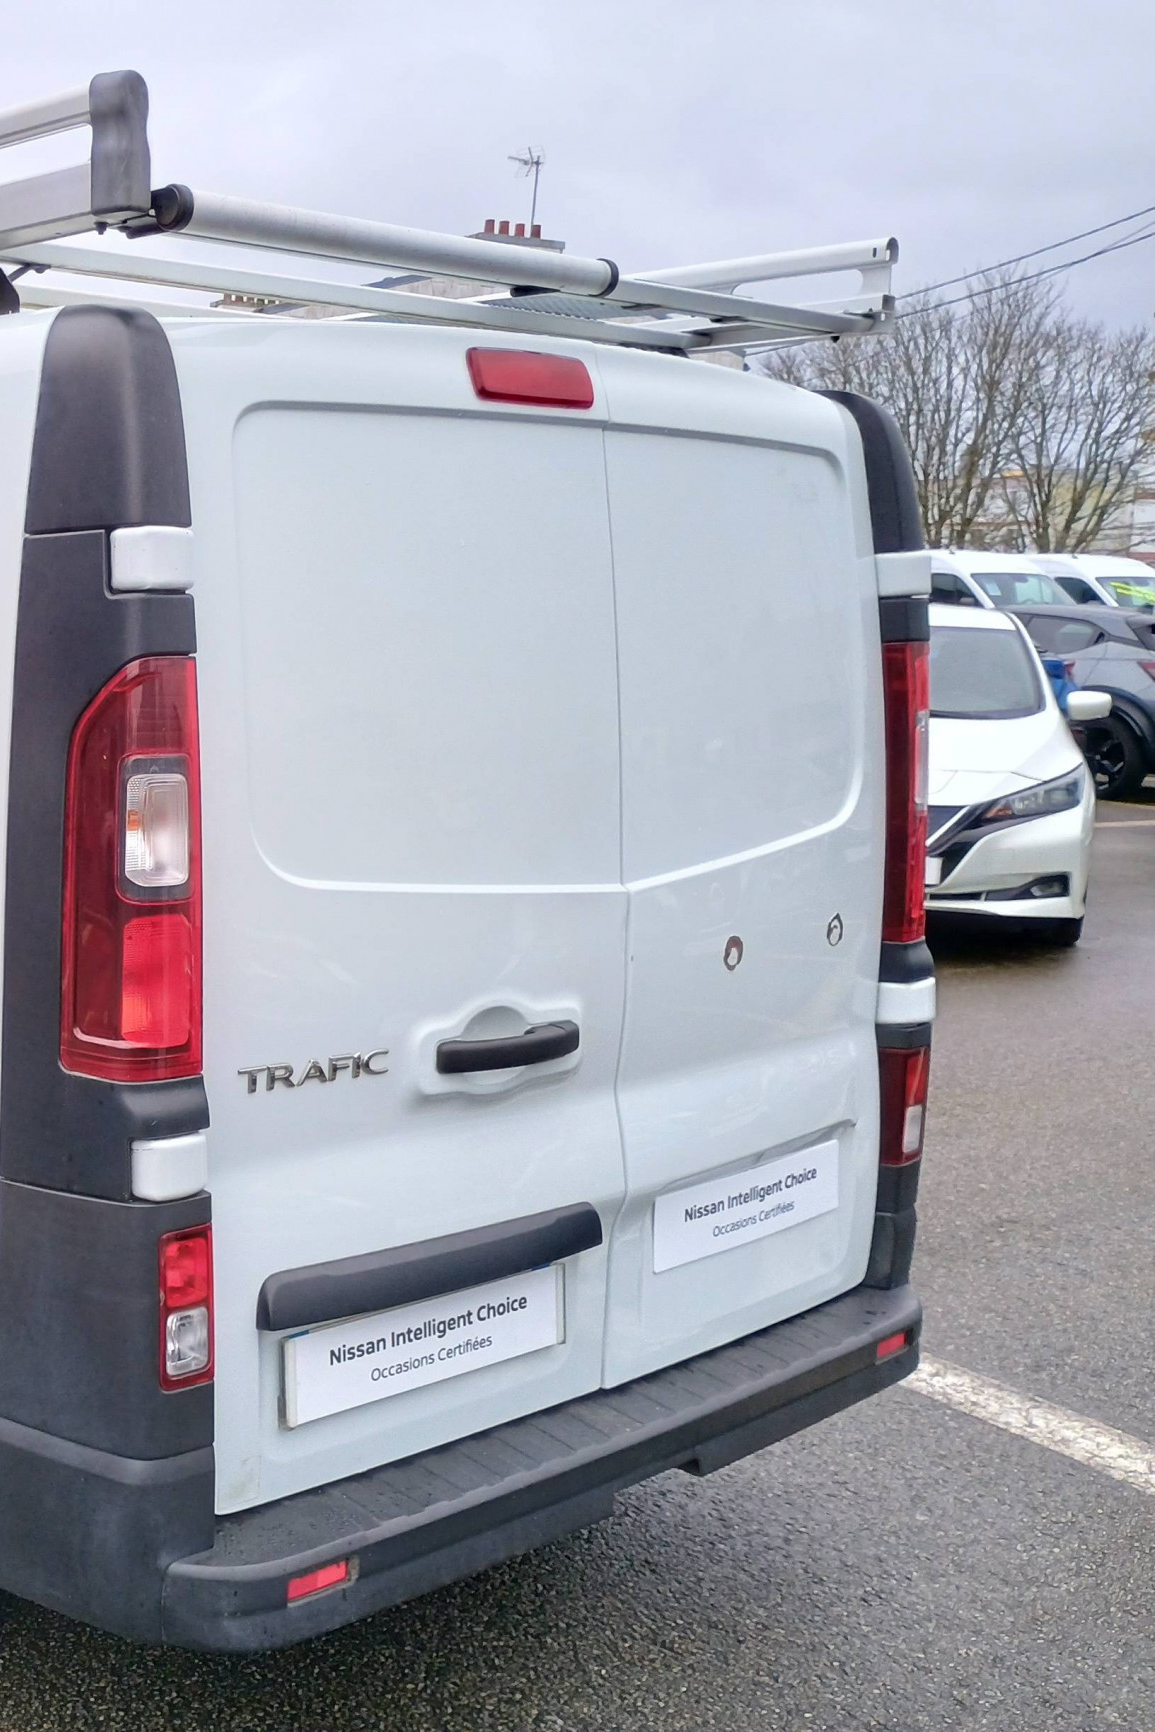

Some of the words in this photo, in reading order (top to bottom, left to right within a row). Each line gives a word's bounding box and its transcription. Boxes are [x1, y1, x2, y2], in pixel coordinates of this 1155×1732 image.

[237, 1048, 390, 1094] TRAFIC
[684, 1200, 725, 1222] Nissan
[727, 1179, 783, 1209] Intelligent
[784, 1167, 818, 1189] Choice
[712, 1214, 757, 1237] Occasions
[758, 1201, 795, 1222] Certifiées
[329, 1337, 387, 1366] Nissan
[391, 1310, 474, 1347] Intelligent
[476, 1296, 528, 1322] Choice
[370, 1352, 435, 1382] Occasions
[437, 1335, 493, 1362] Certifiées
